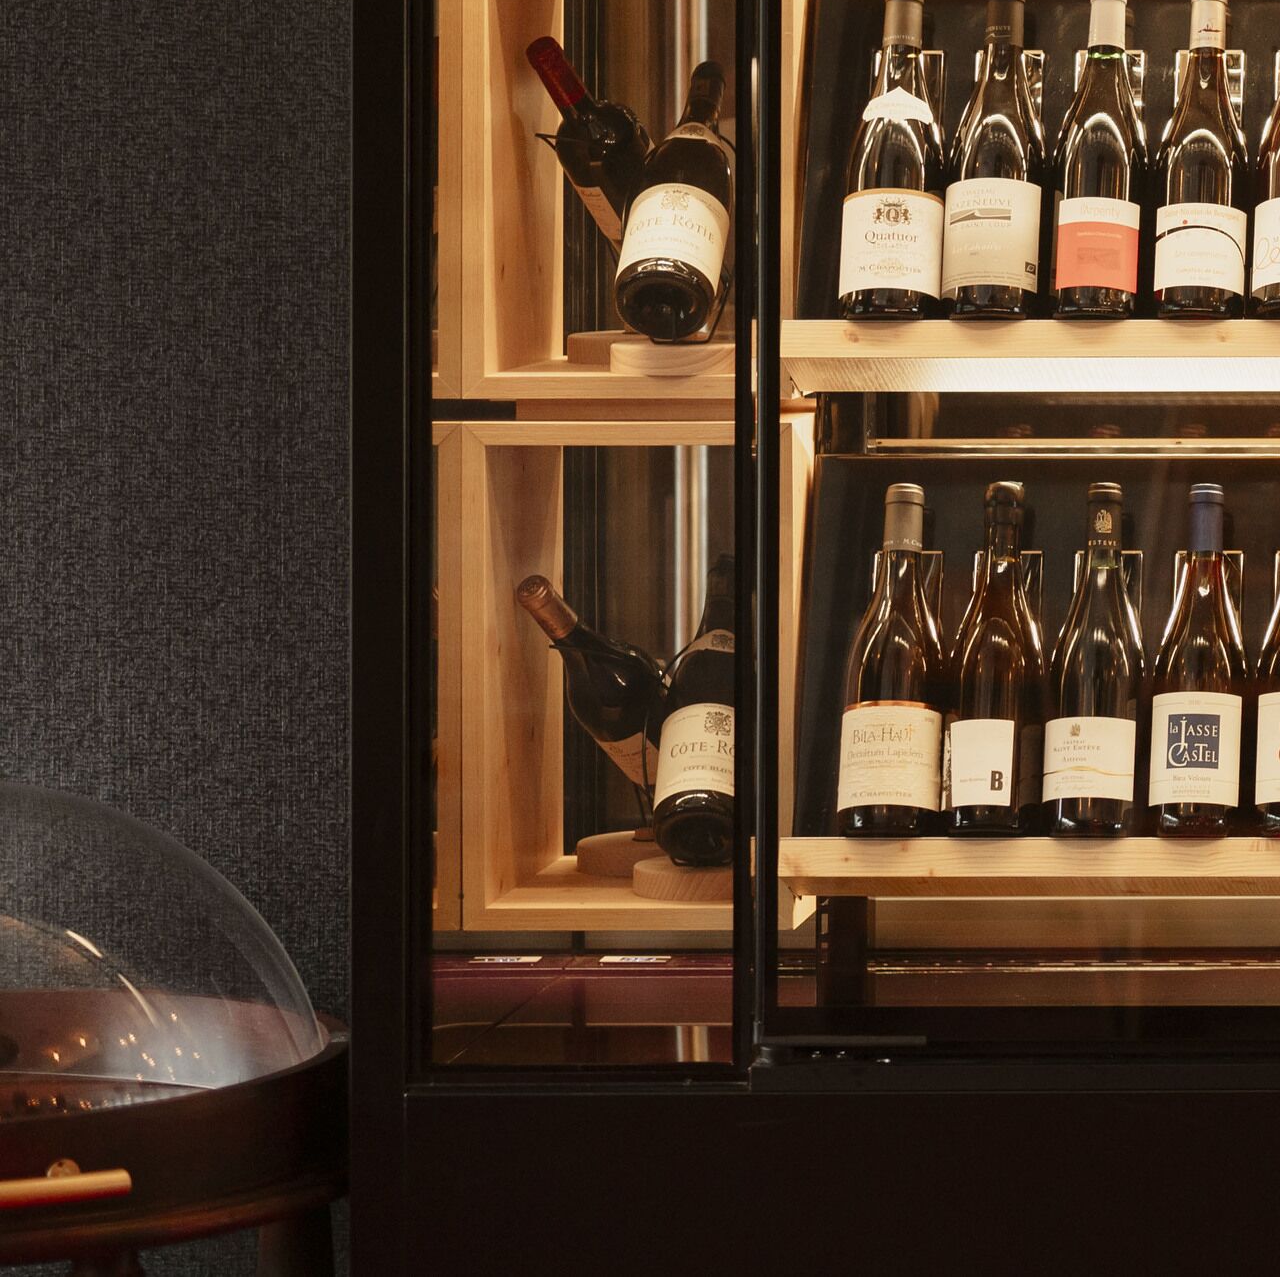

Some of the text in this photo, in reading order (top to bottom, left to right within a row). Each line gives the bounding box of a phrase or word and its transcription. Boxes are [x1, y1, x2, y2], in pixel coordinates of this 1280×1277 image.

[864, 229, 919, 244] Quatuor
[1169, 716, 1218, 757] la JASSE
[1168, 741, 1218, 767] CASTEL
[990, 770, 1004, 791] B
